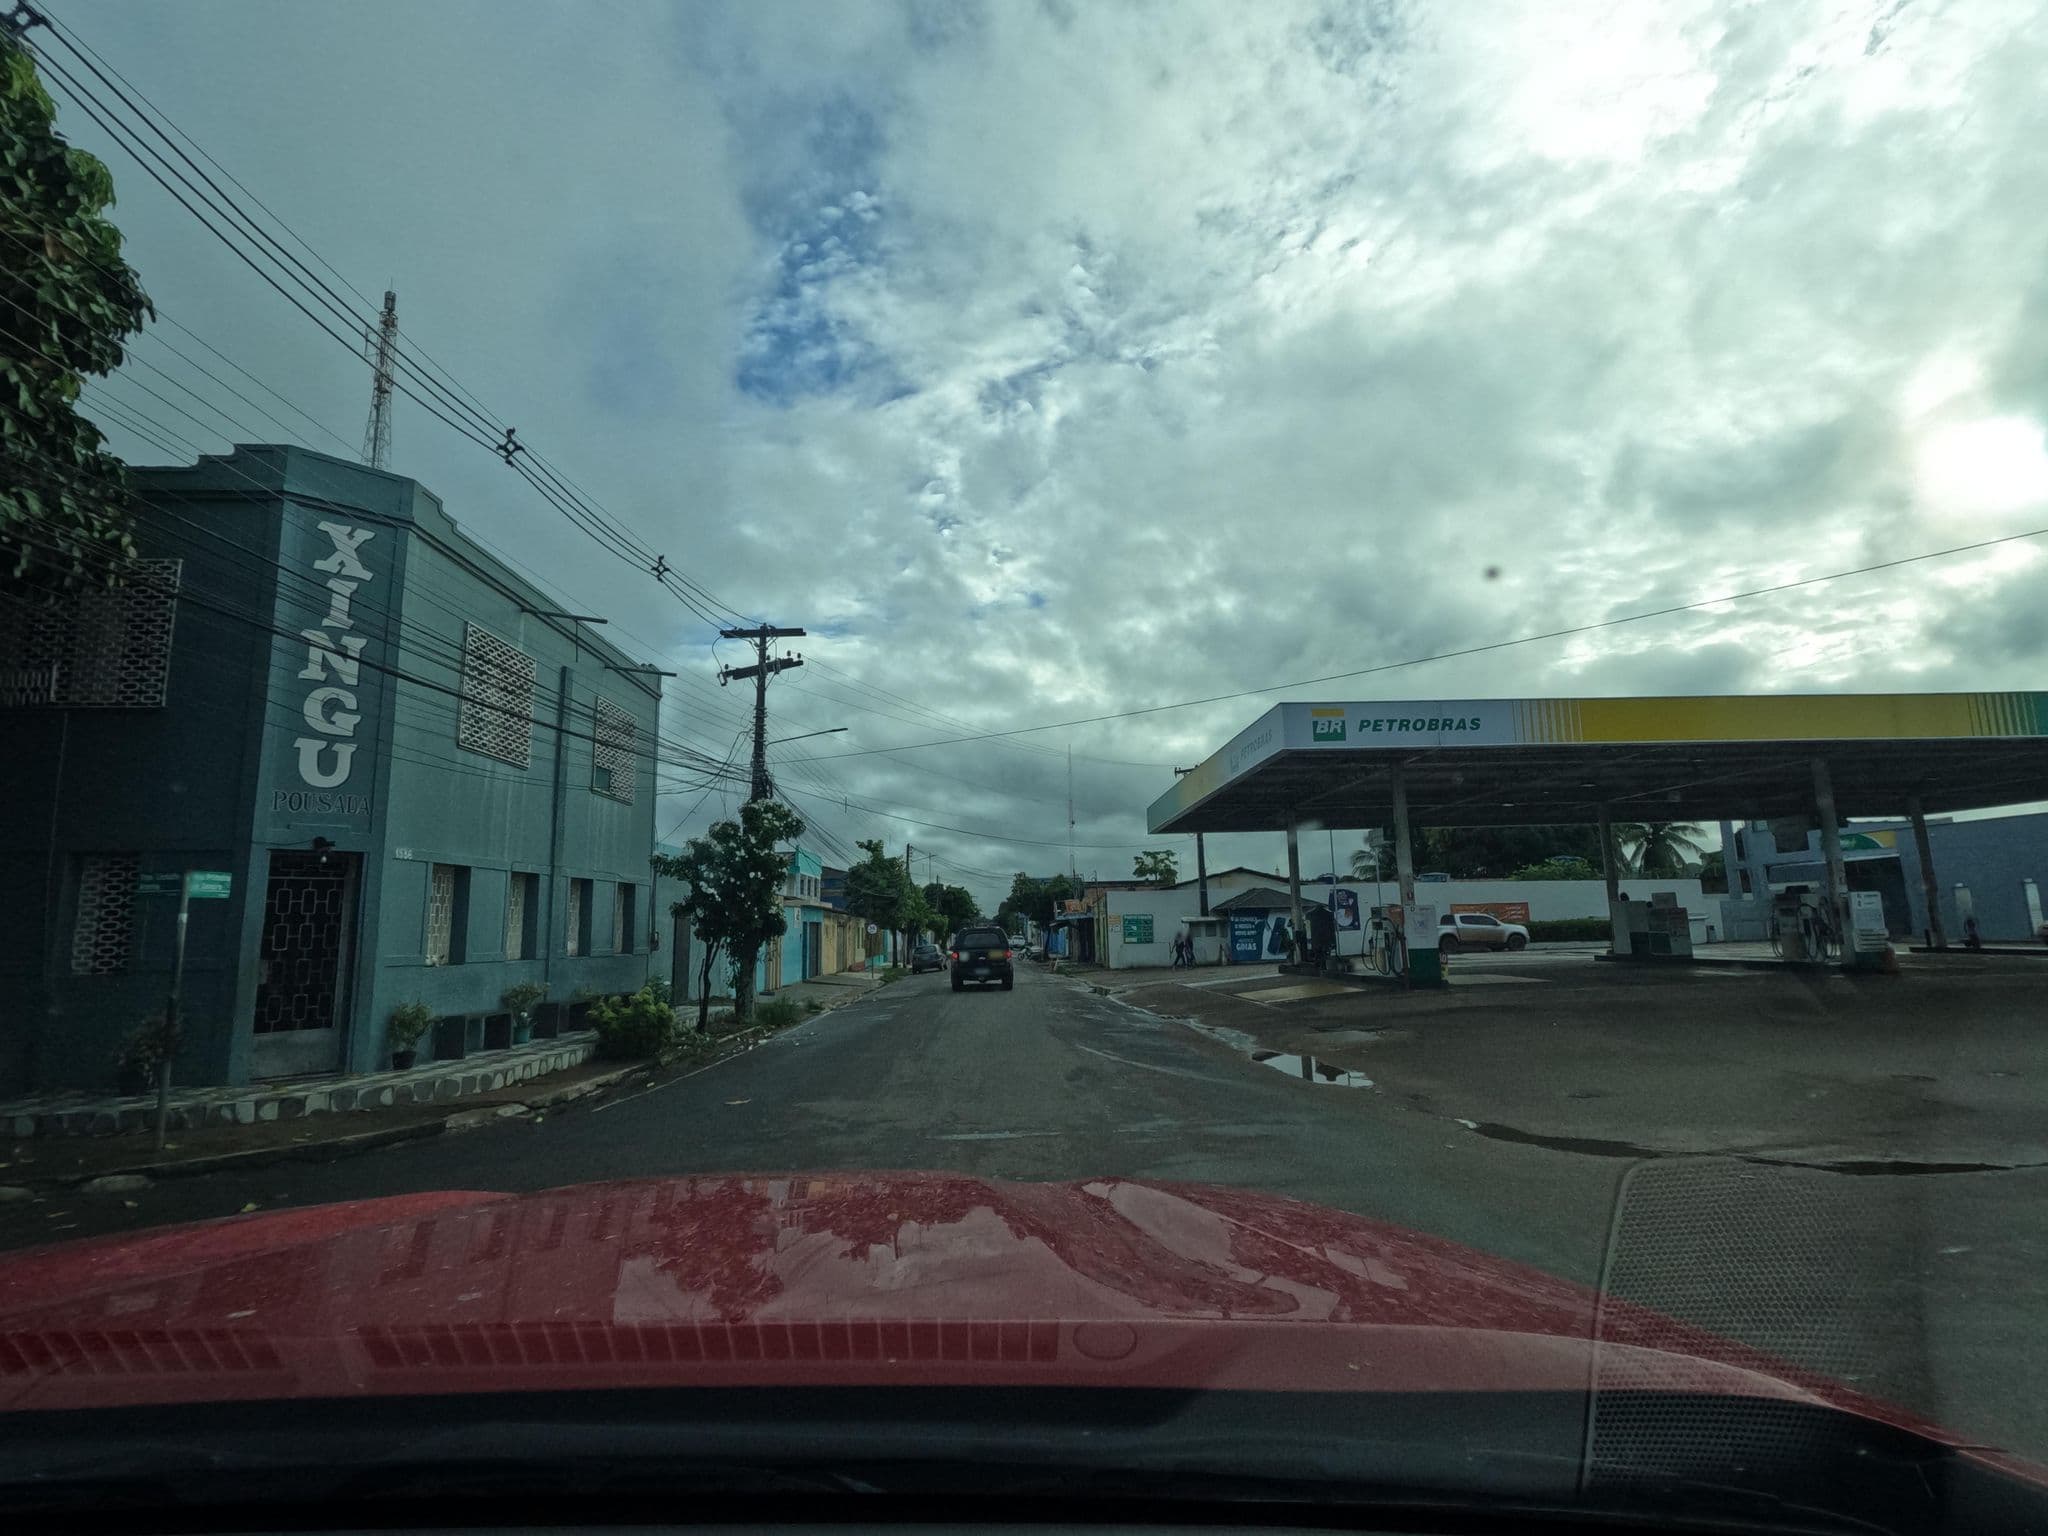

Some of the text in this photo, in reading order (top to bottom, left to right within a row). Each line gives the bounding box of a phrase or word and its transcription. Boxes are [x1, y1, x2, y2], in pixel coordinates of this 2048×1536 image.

[293, 520, 376, 788] XINGU
[1315, 719, 1343, 734] BR
[1358, 717, 1481, 733] PETROBRAS
[272, 790, 370, 815] POUSADA
